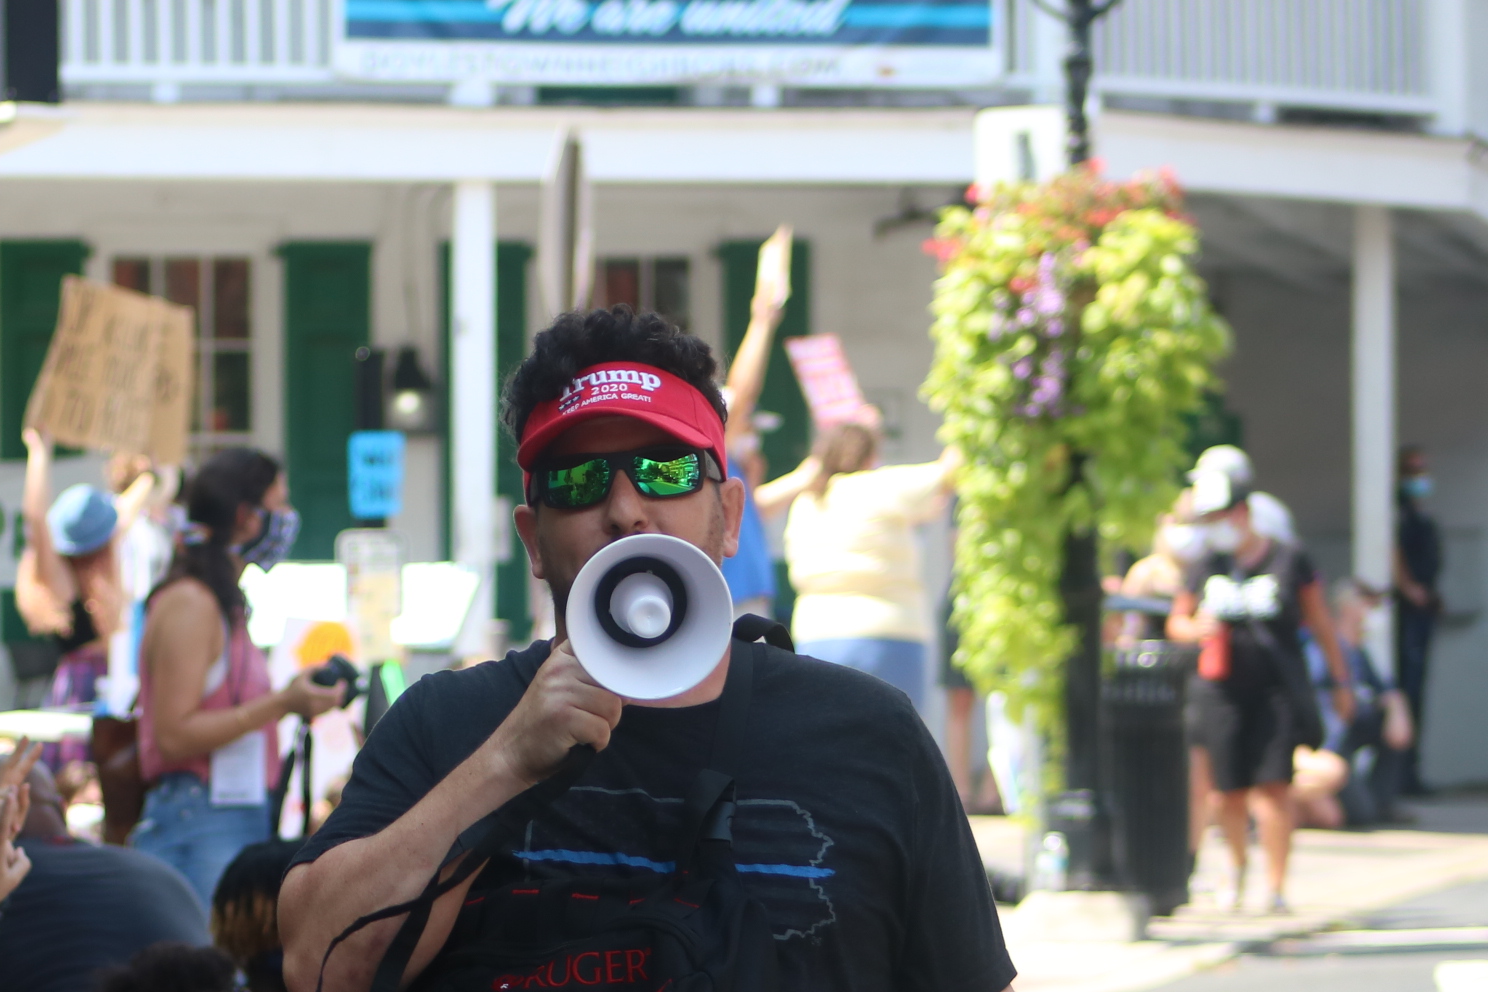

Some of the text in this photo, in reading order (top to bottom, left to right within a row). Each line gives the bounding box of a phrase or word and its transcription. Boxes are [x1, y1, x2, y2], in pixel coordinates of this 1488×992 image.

[591, 383, 628, 395] 2020
[581, 393, 618, 407] AMERICA
[621, 393, 651, 402] GREAT!
